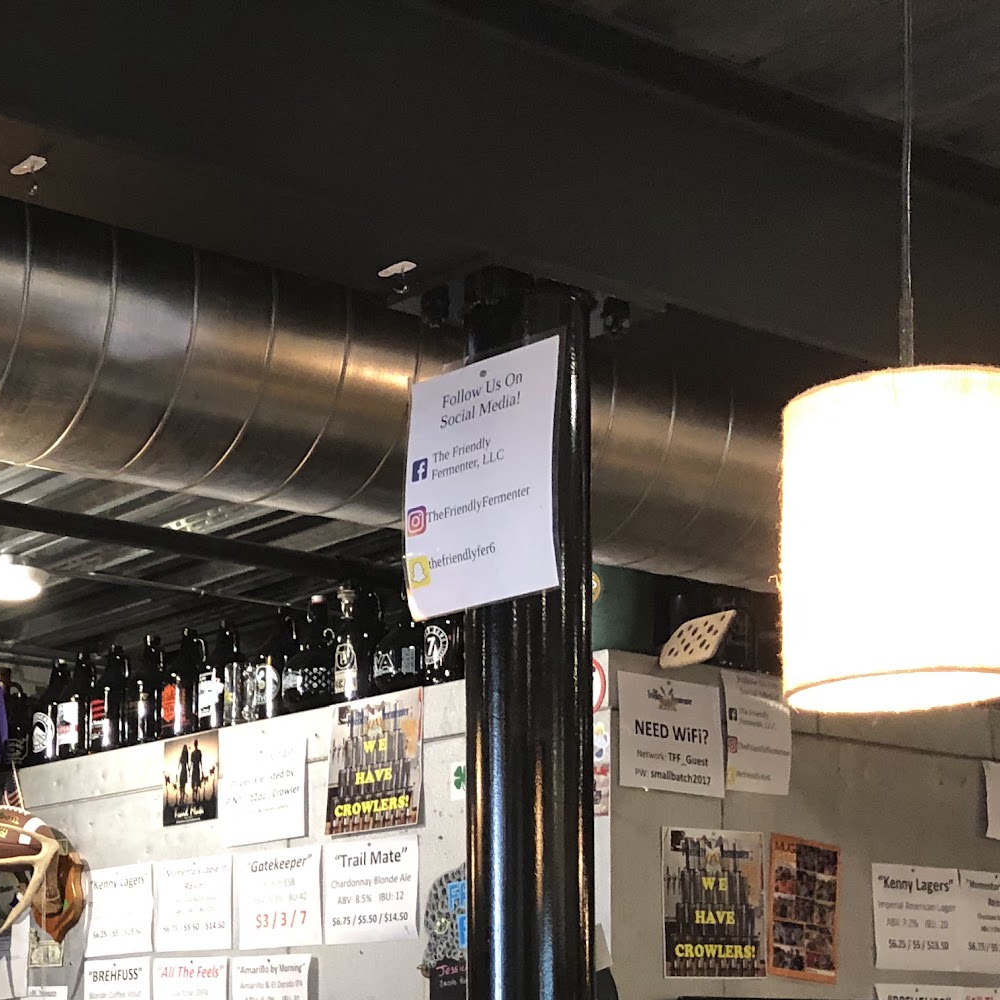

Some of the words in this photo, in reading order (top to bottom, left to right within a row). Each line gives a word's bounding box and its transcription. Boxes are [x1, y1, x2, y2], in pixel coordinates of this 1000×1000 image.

[442, 384, 482, 408] Follow
[485, 378, 502, 393] Us
[505, 371, 523, 386] On
[440, 406, 476, 429] Social
[479, 391, 521, 416] Media!
[432, 448, 450, 464] The
[452, 437, 491, 459] Friendly
[431, 457, 480, 480] Fermenter,
[482, 449, 505, 466] LLC
[427, 486, 531, 523] TheFriendlyFermenter
[429, 542, 496, 570] thefriendlyfer6
[635, 719, 669, 739] NEED
[672, 725, 709, 745] WiFi?
[363, 738, 387, 753] WE
[668, 752, 709, 767] TFF_Guest
[355, 767, 392, 785] HAVE
[635, 768, 649, 778] PW:
[650, 770, 711, 786] smallbatch2017
[334, 795, 410, 818] CROWLERS!
[335, 852, 367, 868] "Trail
[370, 846, 408, 865] Mate"
[331, 879, 372, 890] Chardonnay
[374, 875, 399, 887] Blonde
[400, 873, 412, 883] Ale
[701, 876, 728, 891] WE
[878, 875, 913, 893] "Kenny
[916, 878, 954, 894] Lagers"
[355, 893, 373, 904] 8.5%
[396, 891, 404, 901] 12
[256, 913, 269, 929] $3
[281, 911, 287, 927] 3
[300, 910, 307, 925] 7
[358, 913, 378, 925] $5.50
[384, 911, 409, 923] $14.50
[695, 910, 736, 925] HAVE
[674, 943, 757, 959] CROWLERS!
[89, 967, 143, 982] "BREHFUSS"
[177, 966, 195, 978] The
[196, 964, 225, 978] Feels"
[271, 966, 278, 975] by
